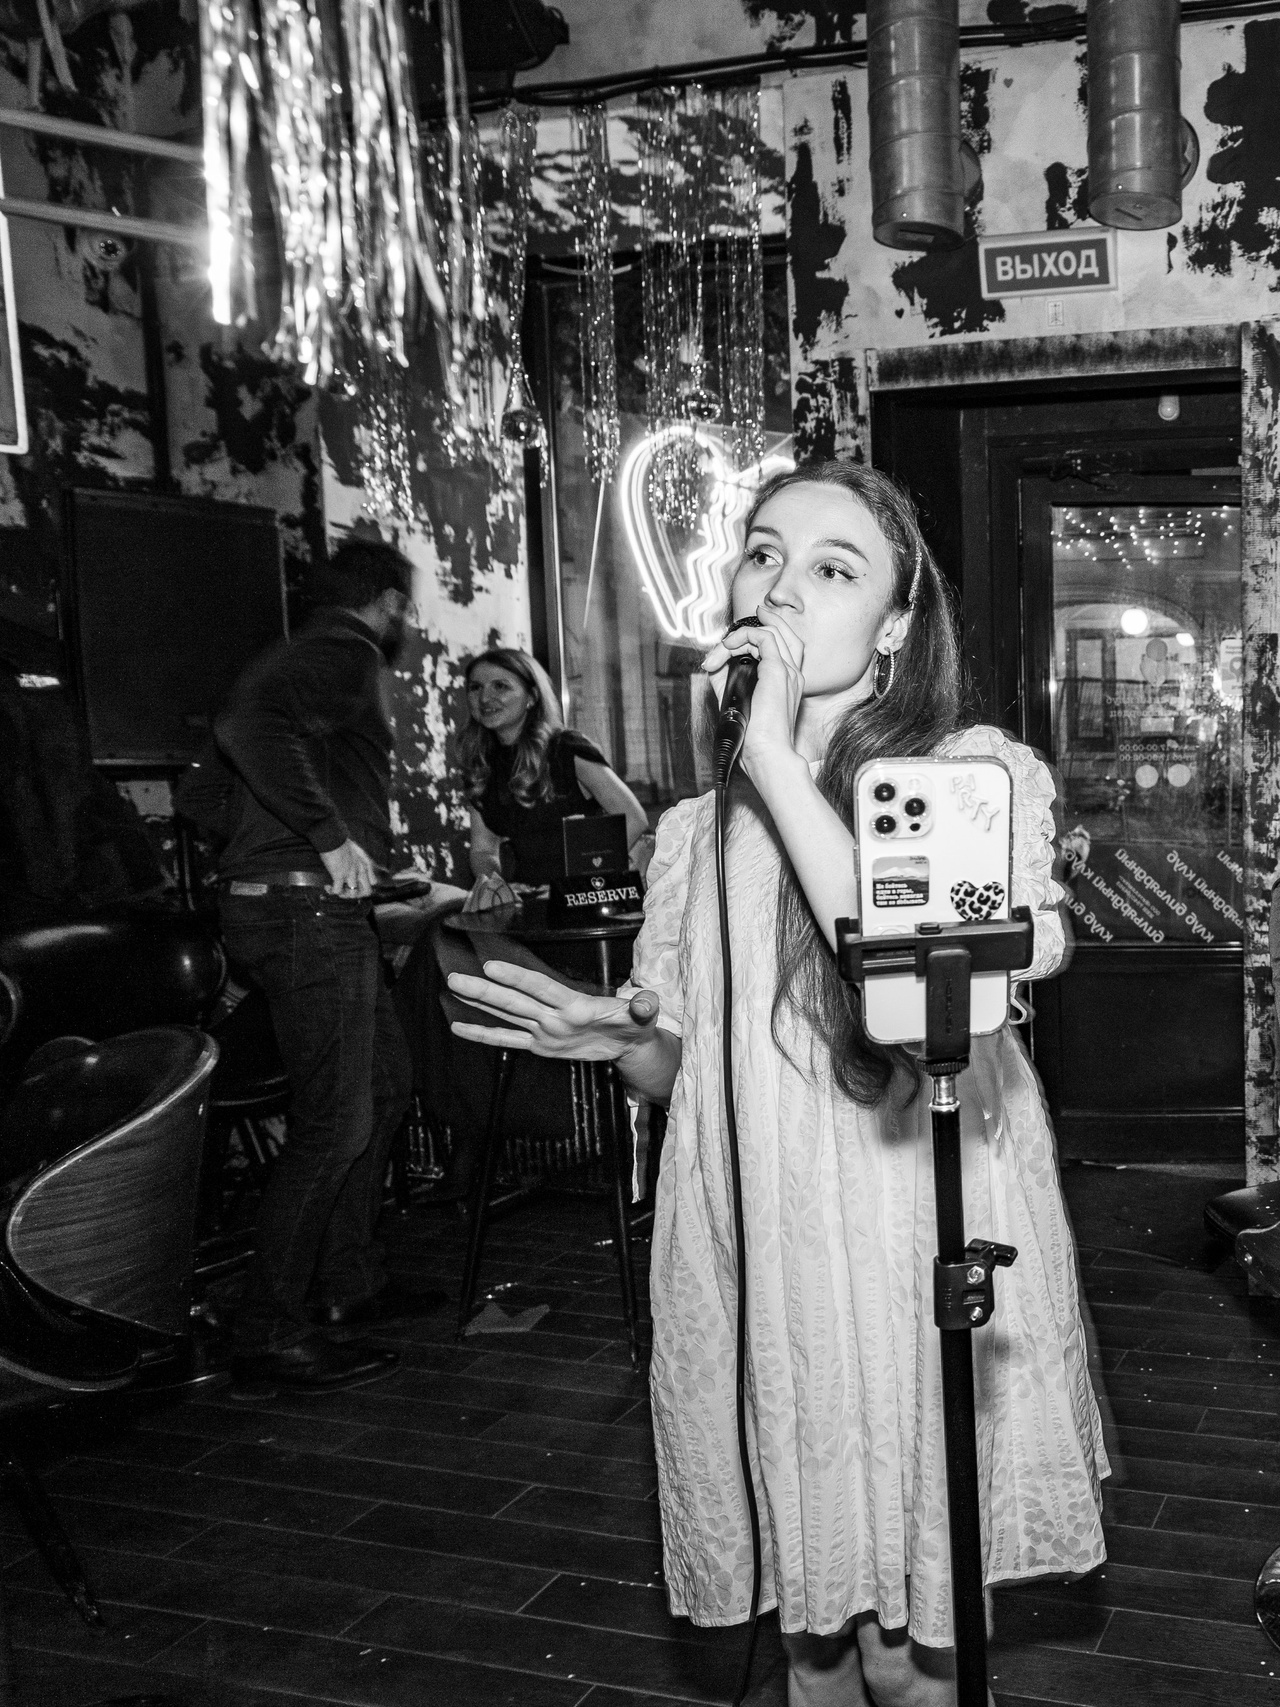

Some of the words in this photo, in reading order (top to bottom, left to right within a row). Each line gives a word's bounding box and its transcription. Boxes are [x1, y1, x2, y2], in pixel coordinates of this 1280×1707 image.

[995, 248, 1100, 282] ВЫХОД
[949, 773, 1001, 833] PARTY
[564, 886, 640, 907] RESERVE
